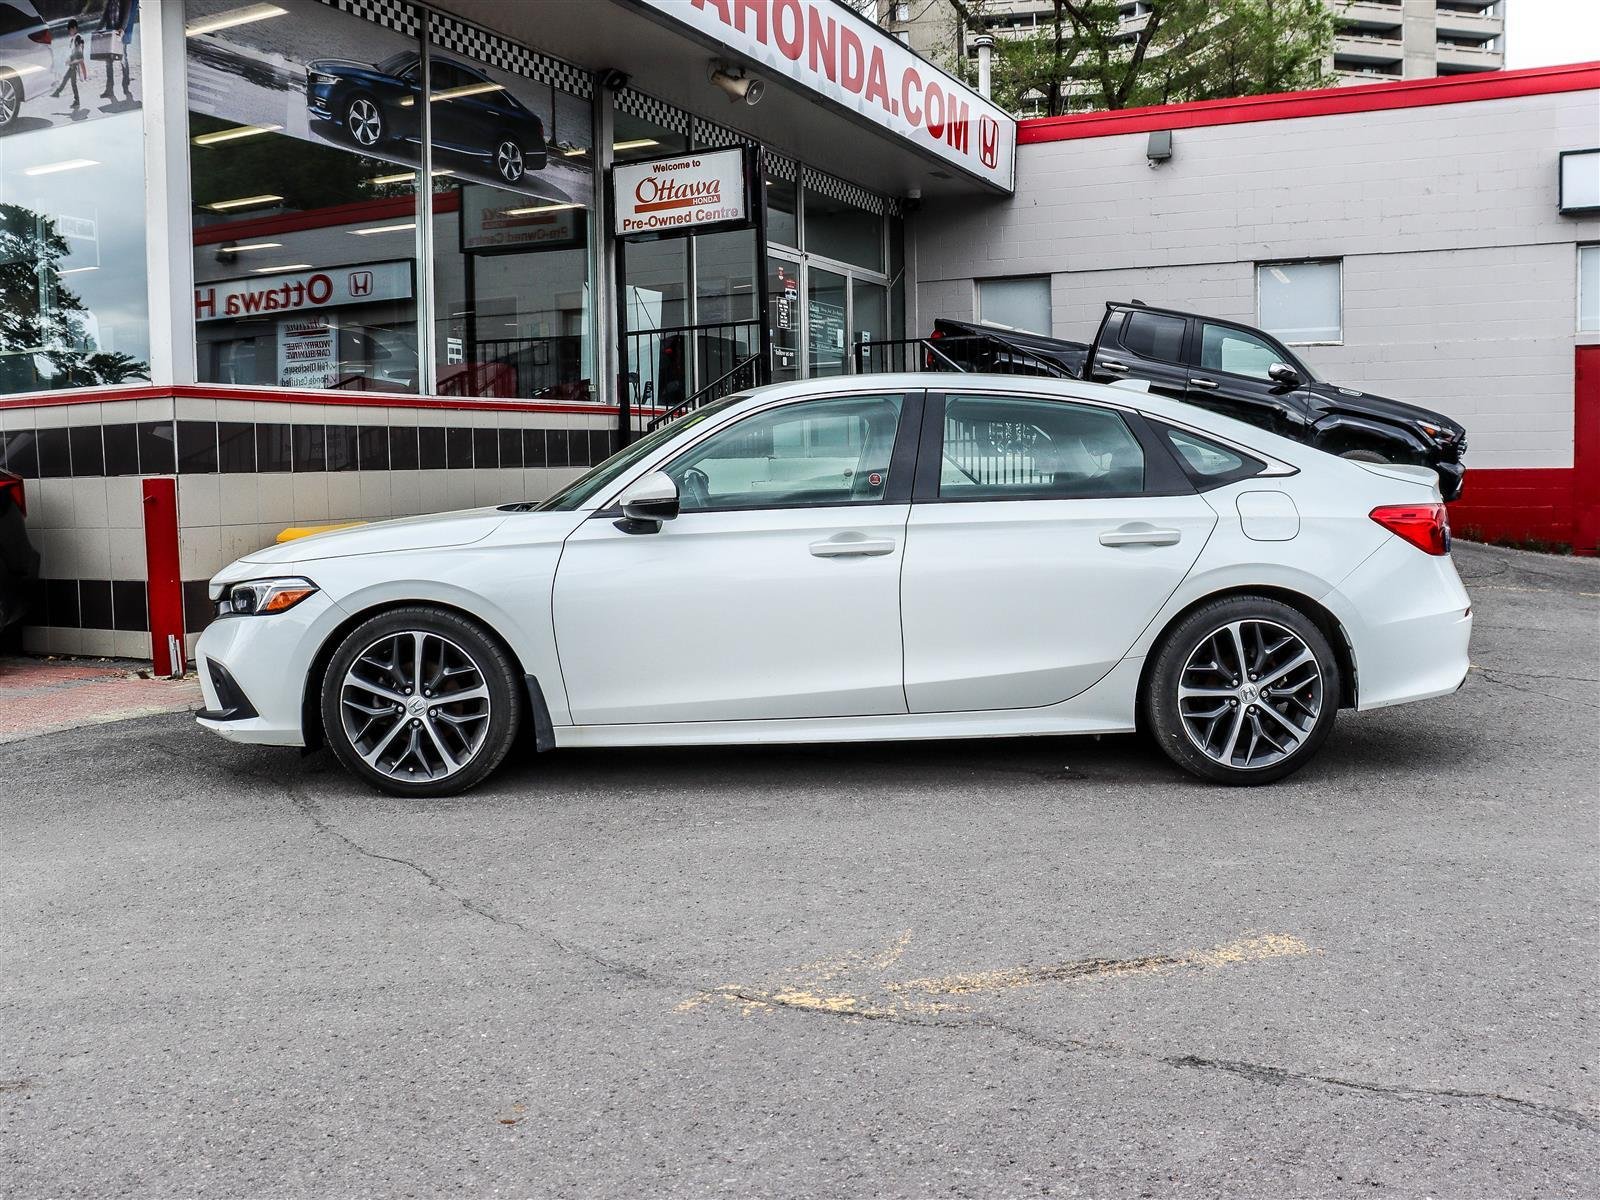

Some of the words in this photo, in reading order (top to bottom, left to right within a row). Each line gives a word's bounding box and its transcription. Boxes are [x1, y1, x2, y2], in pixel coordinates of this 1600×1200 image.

[653, 162, 690, 173] Welcome
[692, 159, 701, 167] to
[635, 176, 721, 203] Ottawa
[692, 195, 718, 205] HONDA
[623, 211, 691, 230] Pre-Owned
[696, 206, 739, 221] Centre
